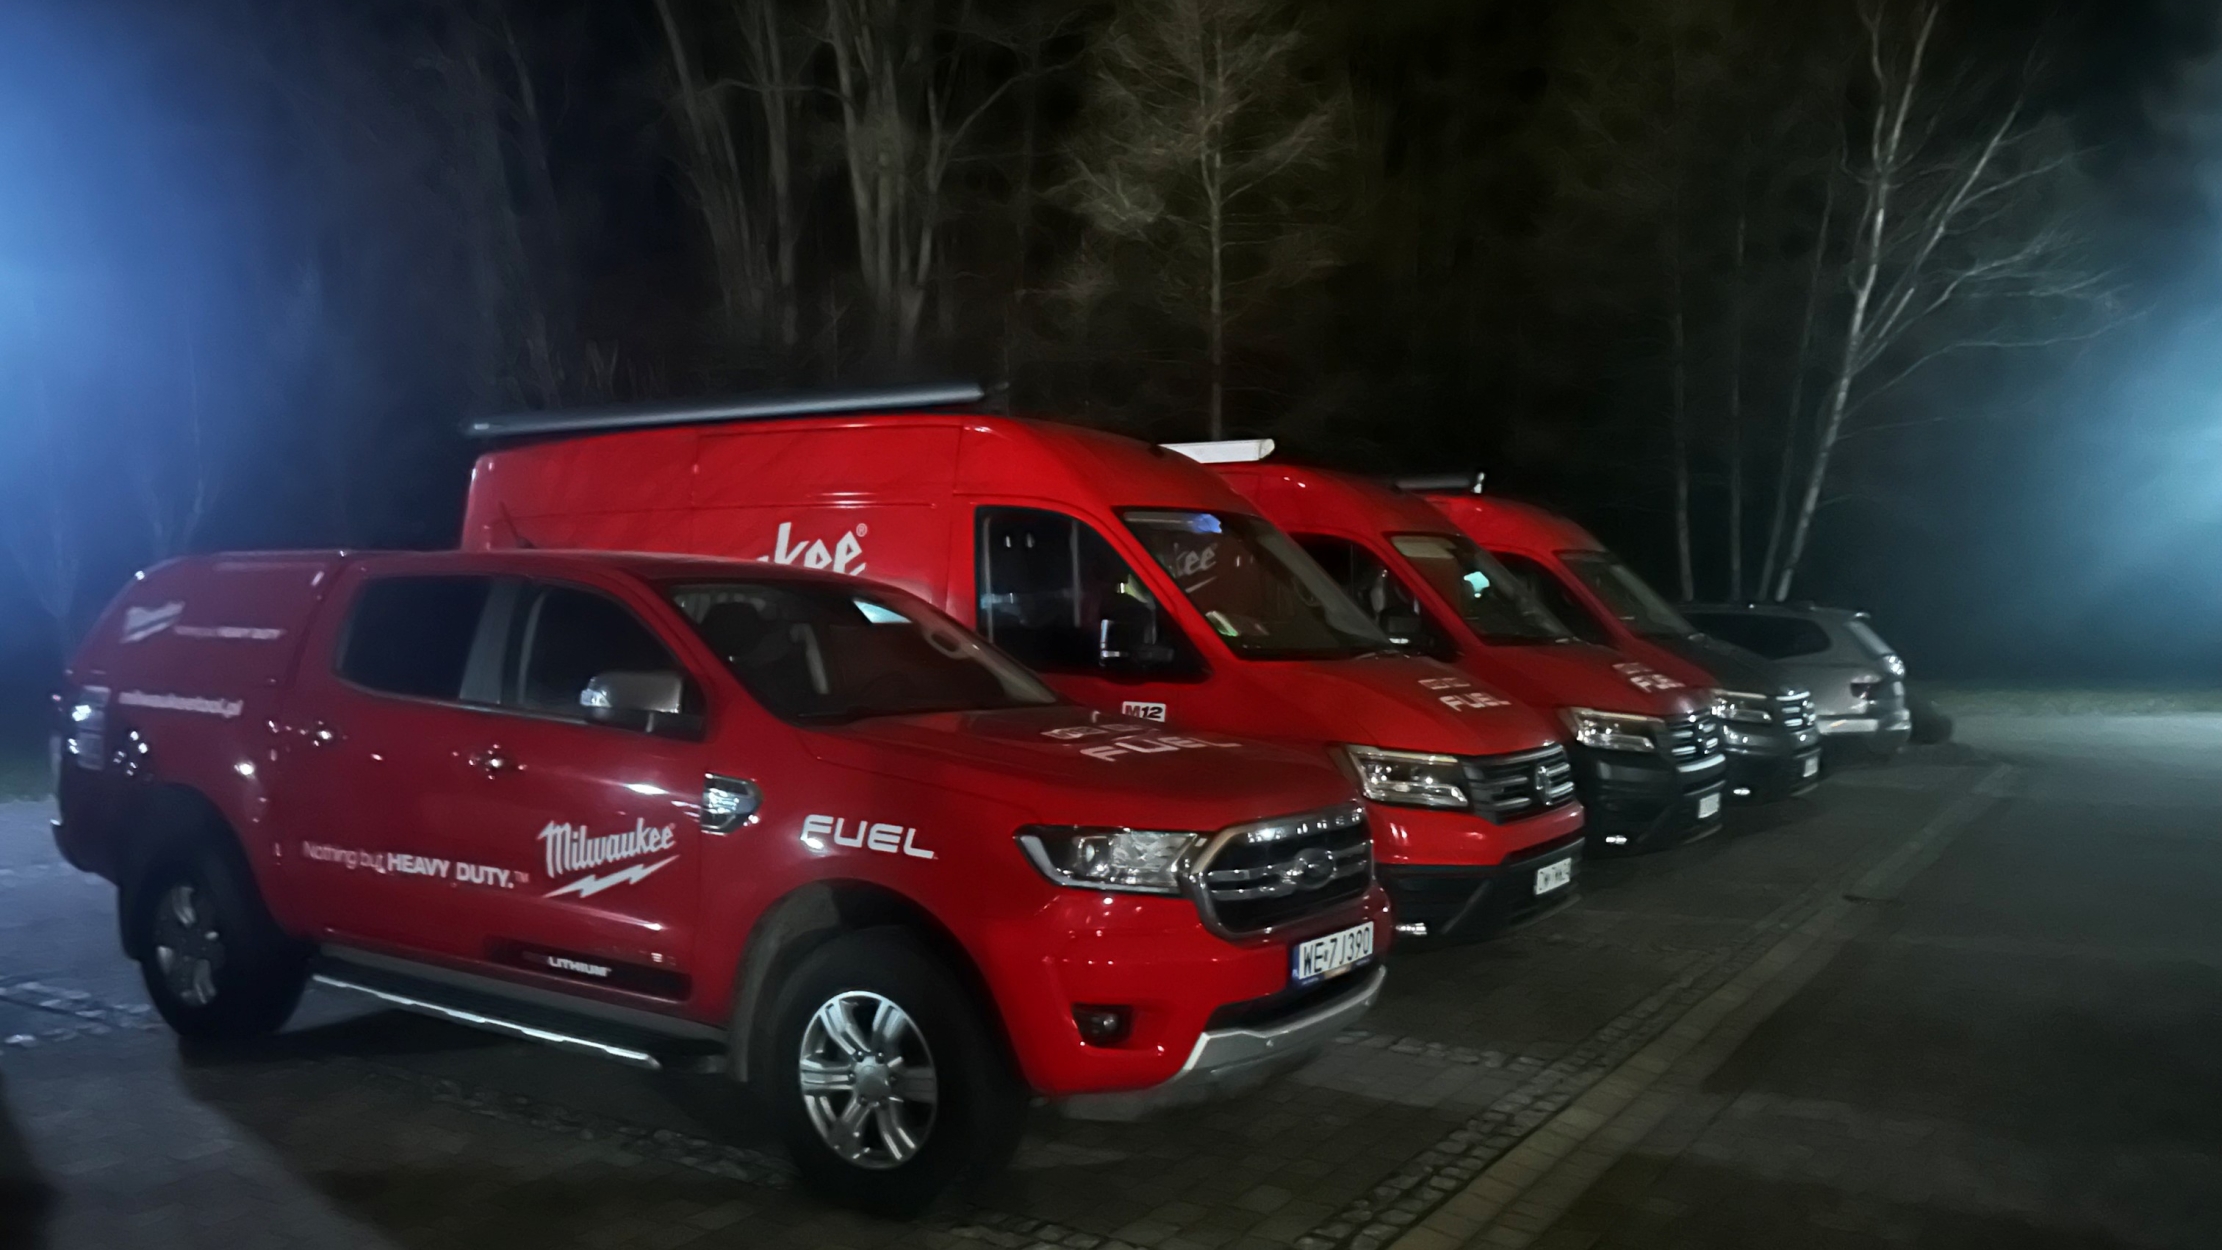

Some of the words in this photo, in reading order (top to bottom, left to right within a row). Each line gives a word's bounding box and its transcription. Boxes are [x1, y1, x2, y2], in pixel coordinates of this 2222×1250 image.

[1125, 705, 1164, 720] M12
[1080, 736, 1242, 762] FUEL
[536, 817, 676, 879] Milwaukee
[800, 814, 934, 859] FUEL
[387, 852, 449, 878] HEAVY
